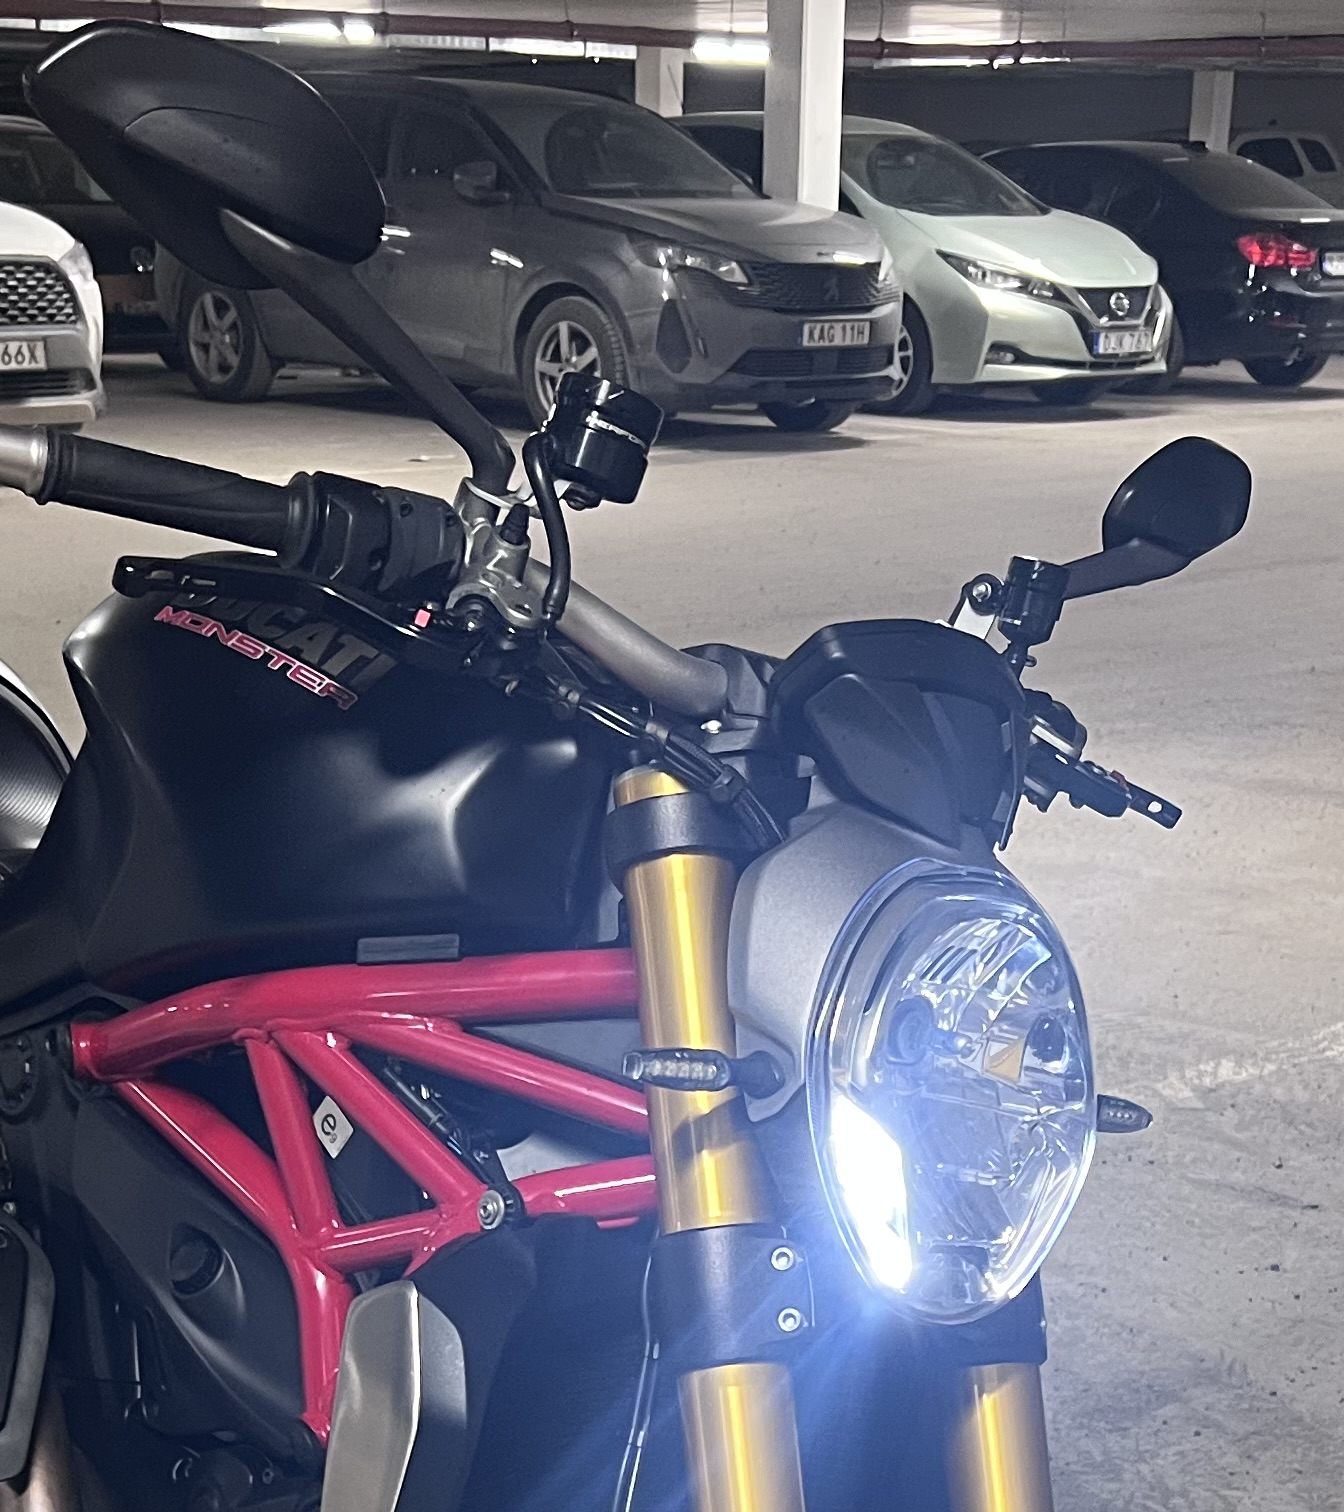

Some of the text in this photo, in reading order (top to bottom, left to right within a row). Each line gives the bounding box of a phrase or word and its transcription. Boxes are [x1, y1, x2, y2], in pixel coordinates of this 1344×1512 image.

[807, 323, 865, 344] KAG 11H
[1, 344, 38, 366] 66X
[153, 605, 358, 711] MONSTER
